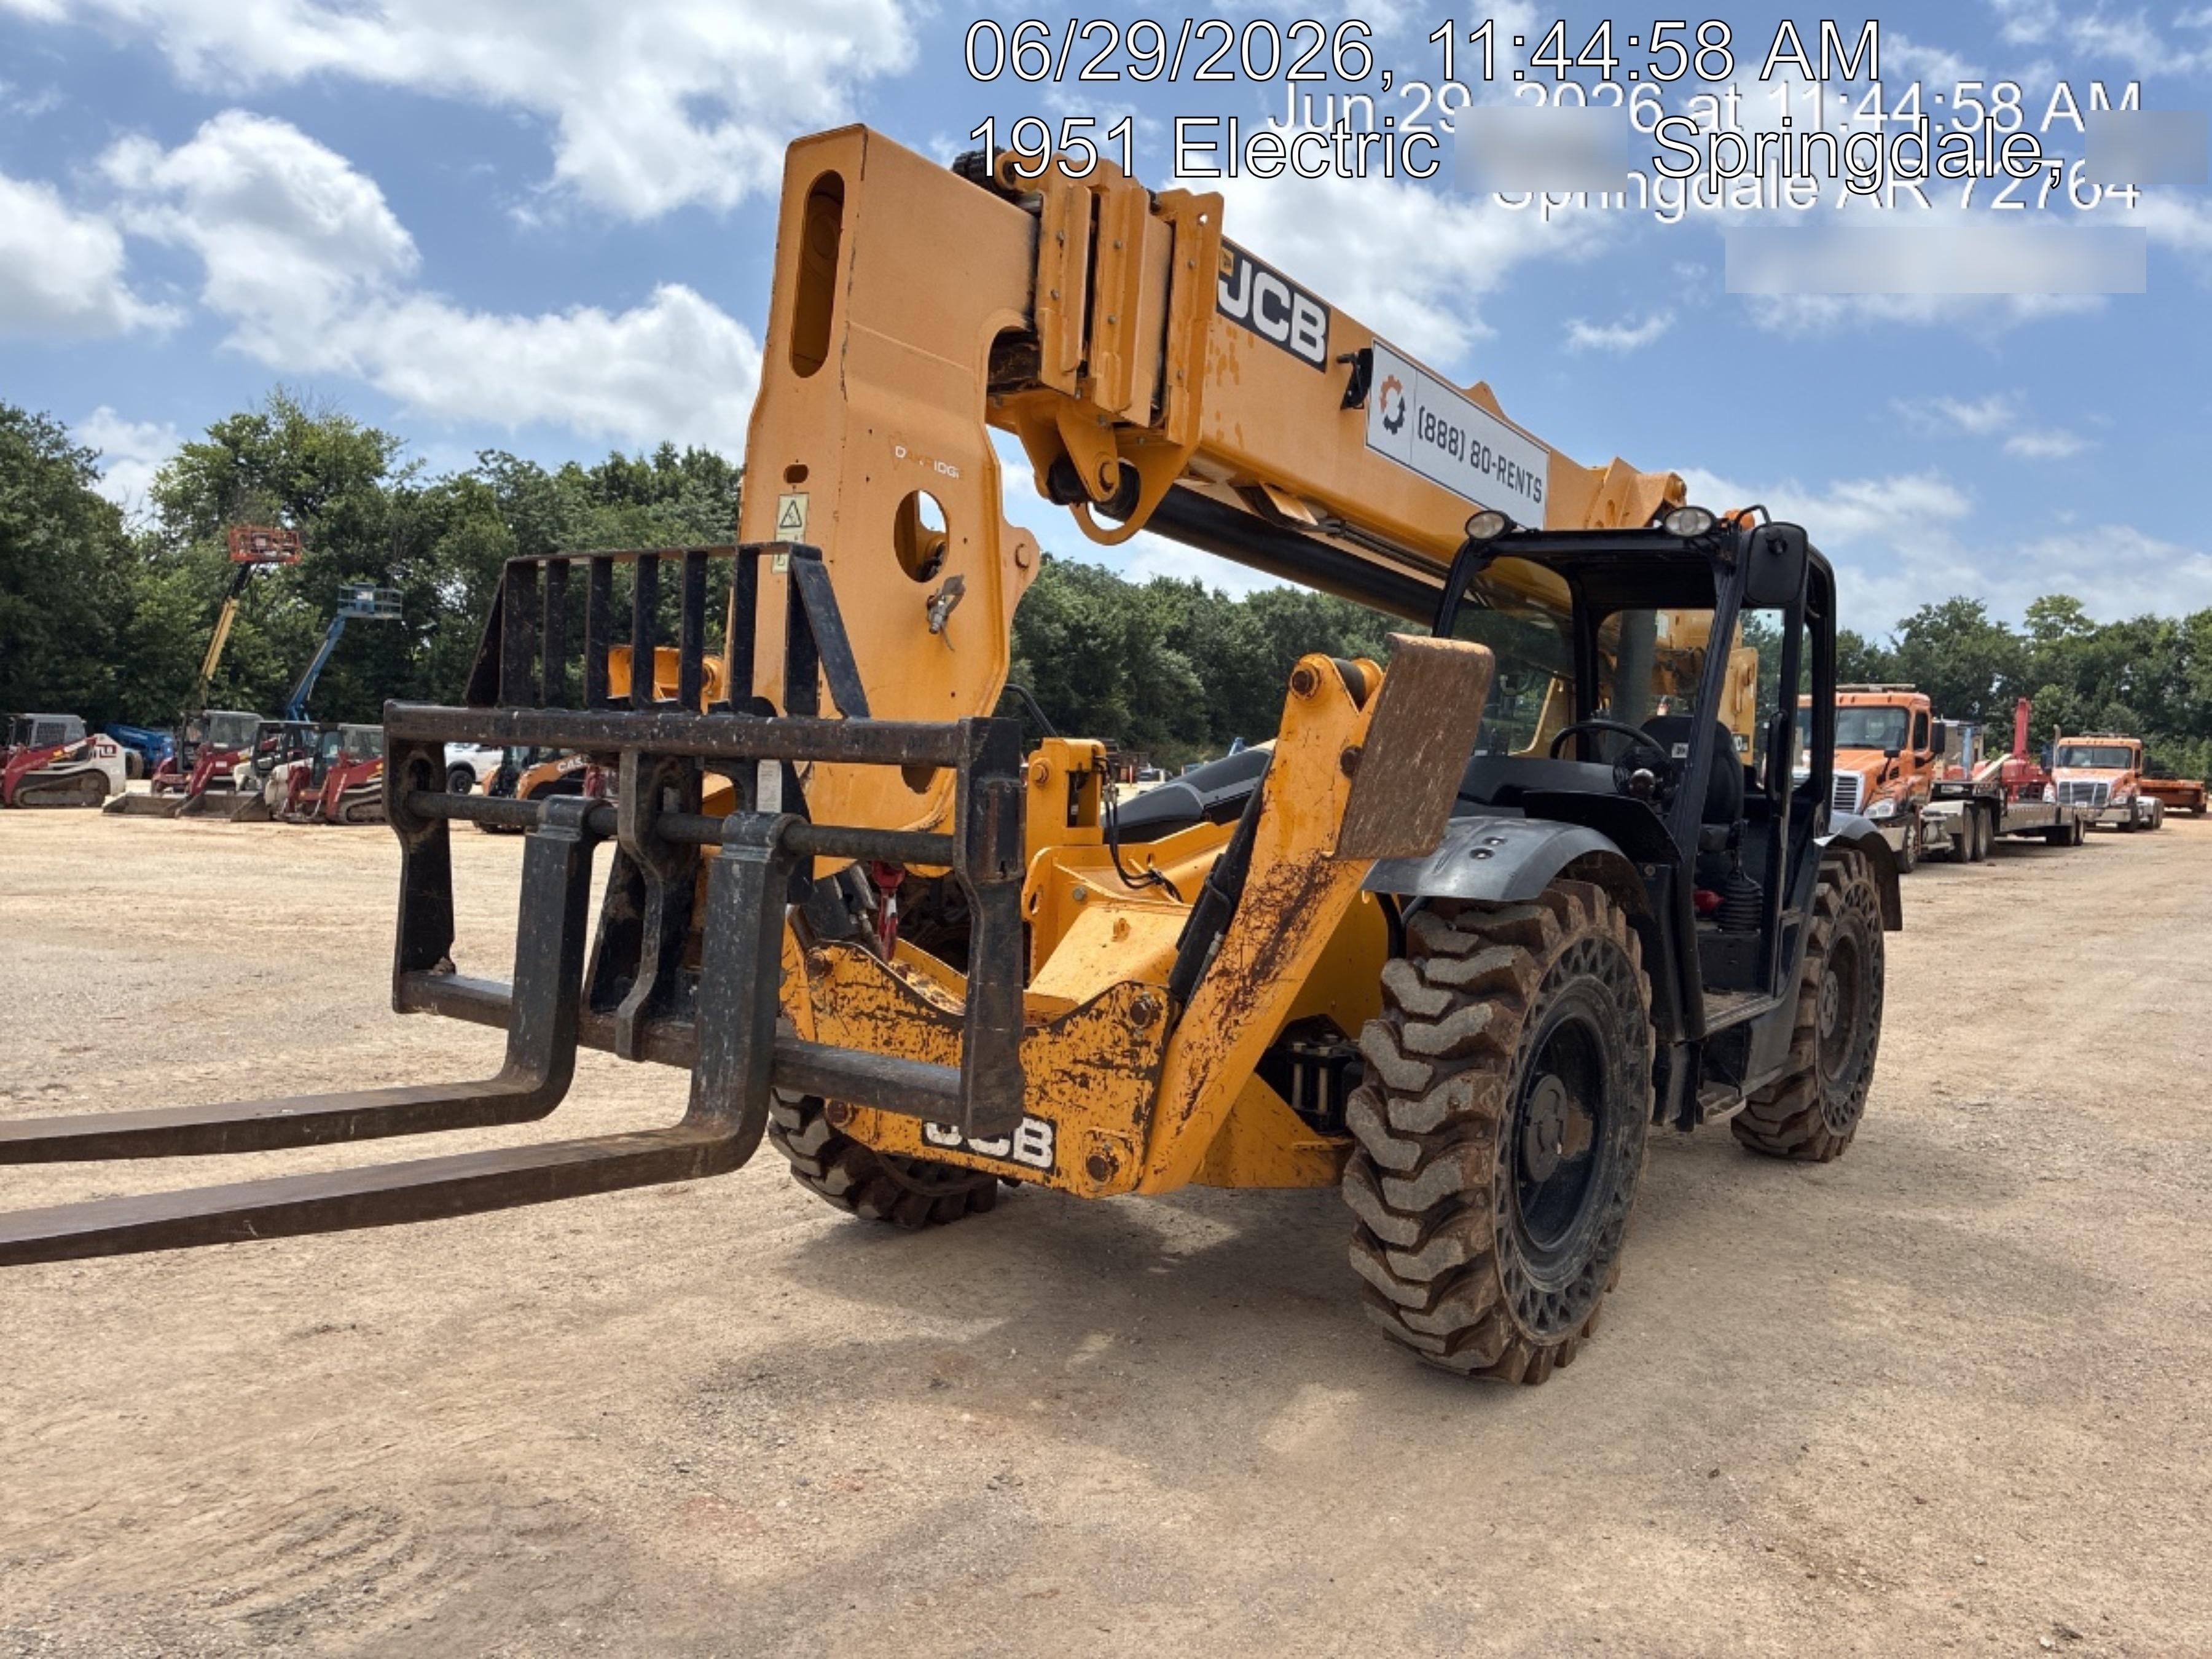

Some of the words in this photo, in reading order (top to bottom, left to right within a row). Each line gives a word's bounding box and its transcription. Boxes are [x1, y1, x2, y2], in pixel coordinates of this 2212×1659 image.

[1218, 259, 1327, 363] JCB
[1418, 405, 1465, 463] (888)
[1470, 439, 1542, 504] 80-RENTS
